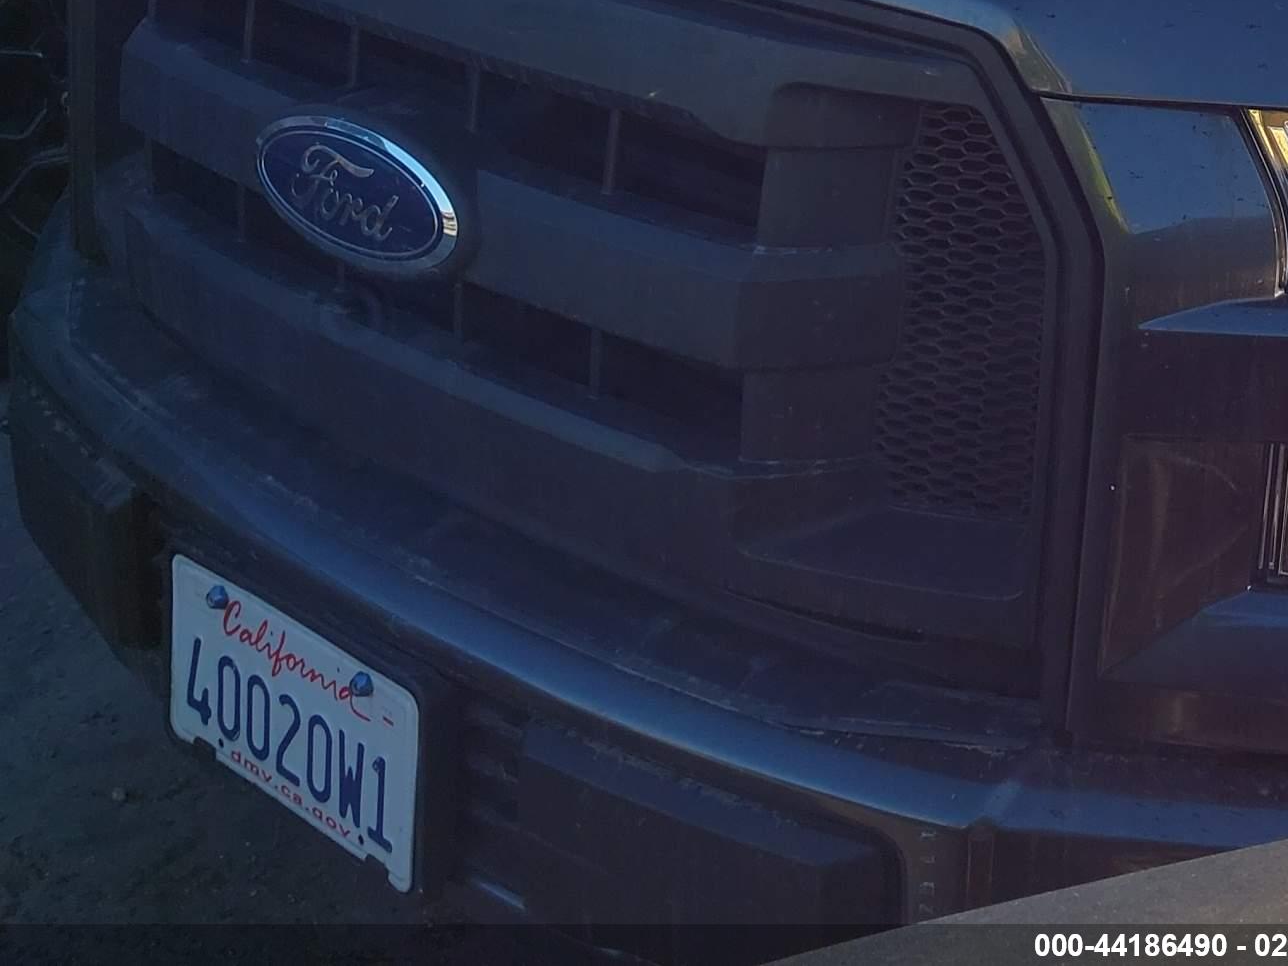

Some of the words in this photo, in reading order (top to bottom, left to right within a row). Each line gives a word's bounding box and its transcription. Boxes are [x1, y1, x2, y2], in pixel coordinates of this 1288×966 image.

[291, 142, 400, 241] Ford
[222, 600, 371, 722] California
[187, 637, 393, 854] 40020W1
[230, 749, 351, 838] dmv.ca.gov
